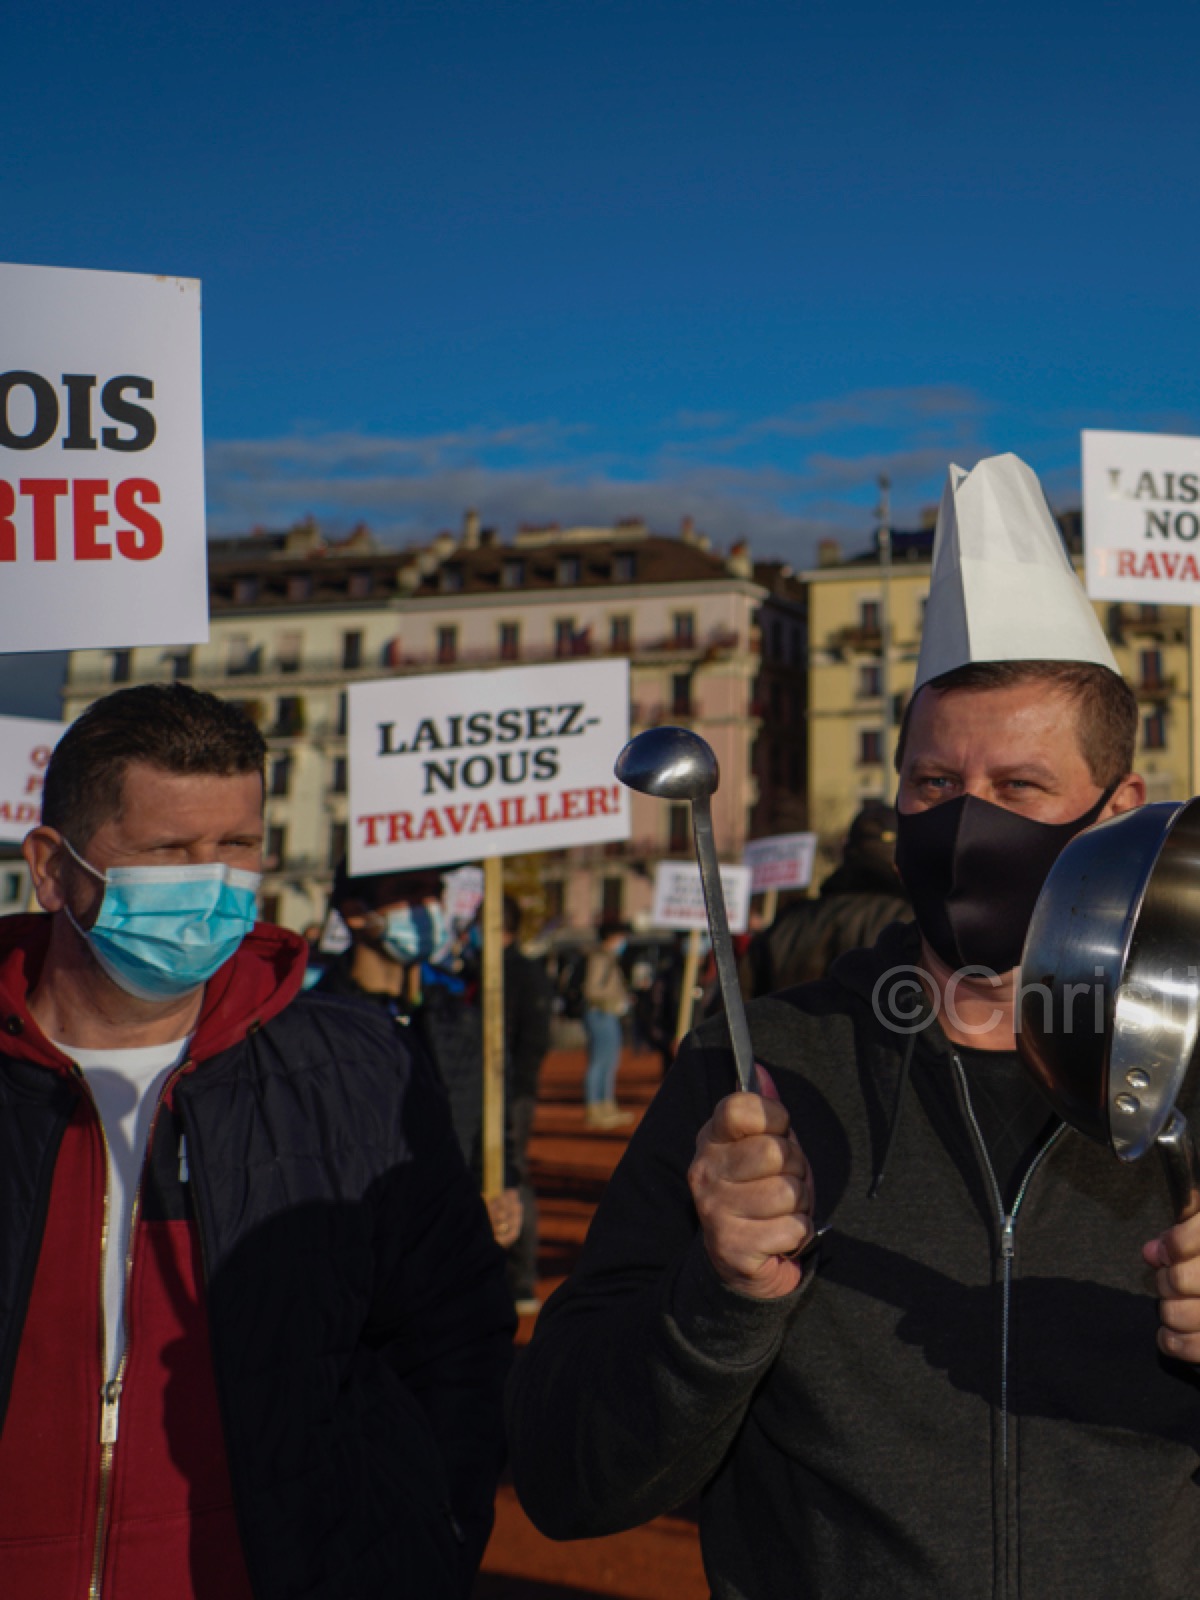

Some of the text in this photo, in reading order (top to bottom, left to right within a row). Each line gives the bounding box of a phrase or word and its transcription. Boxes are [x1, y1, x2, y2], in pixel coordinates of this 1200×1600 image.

[0, 370, 157, 452] OIS
[377, 702, 602, 757] LAISSEZ-
[422, 747, 560, 795] NOUS
[357, 784, 621, 848] TRAVAILLER!
